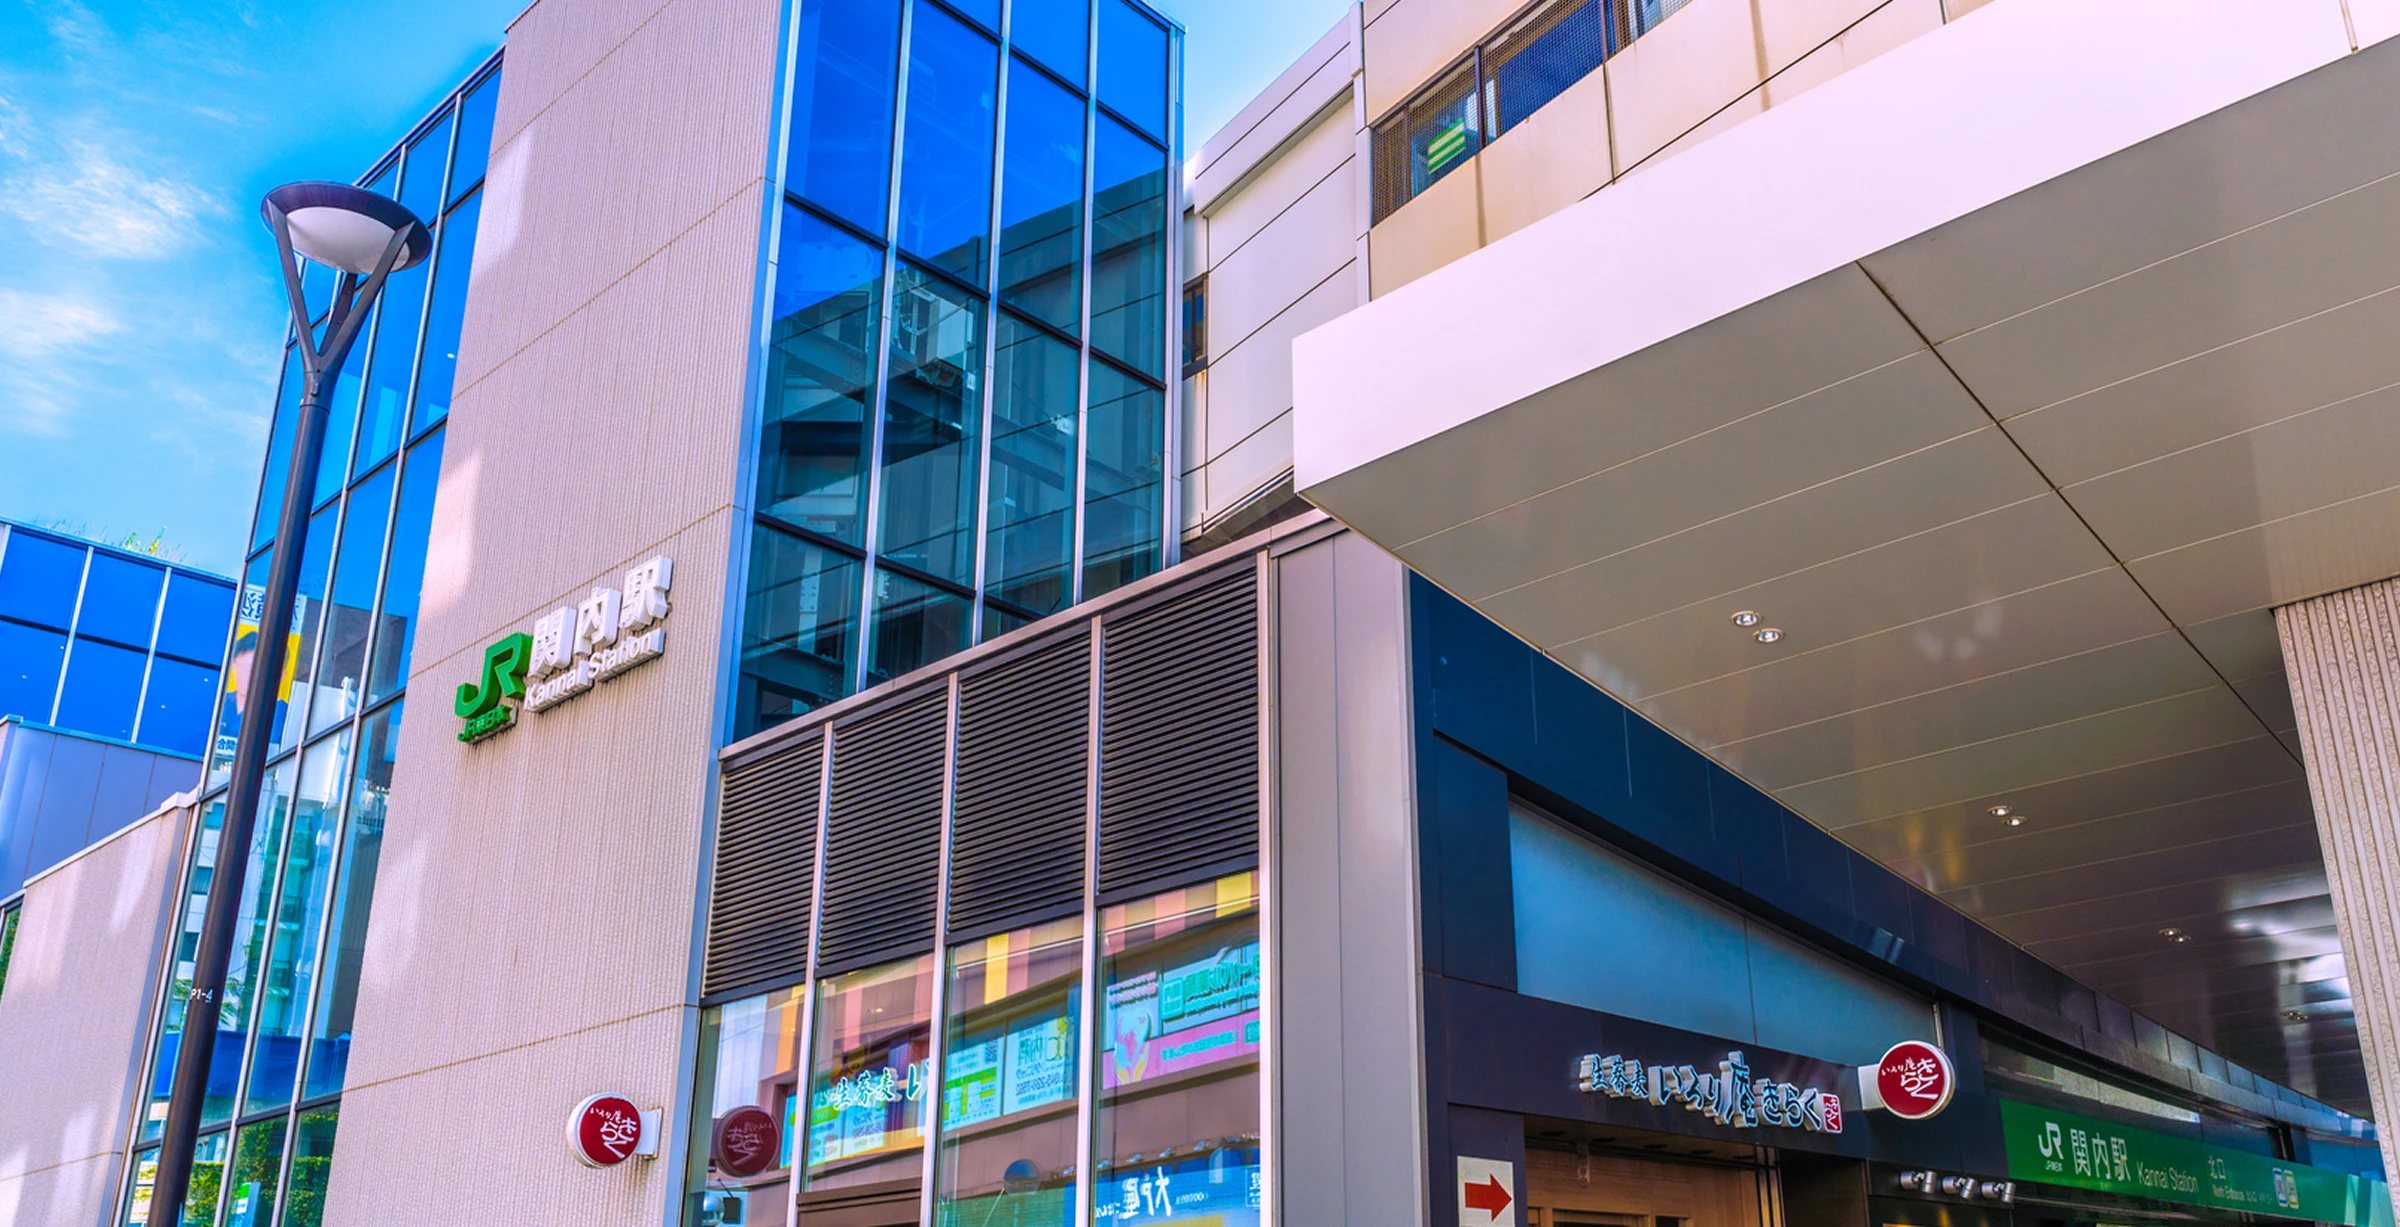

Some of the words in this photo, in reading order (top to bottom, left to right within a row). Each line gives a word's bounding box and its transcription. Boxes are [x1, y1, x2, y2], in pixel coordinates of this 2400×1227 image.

[526, 554, 673, 678] 関内駅
[454, 631, 533, 719] JR
[524, 660, 593, 714] Kannai
[587, 627, 666, 684] Station
[190, 988, 213, 1000] P1-4
[1900, 1057, 1939, 1100] きらく
[2038, 1121, 2064, 1160] JR
[2069, 1127, 2132, 1183] 関内駅
[2136, 1160, 2170, 1188] Kannai
[2168, 1166, 2199, 1194] Station
